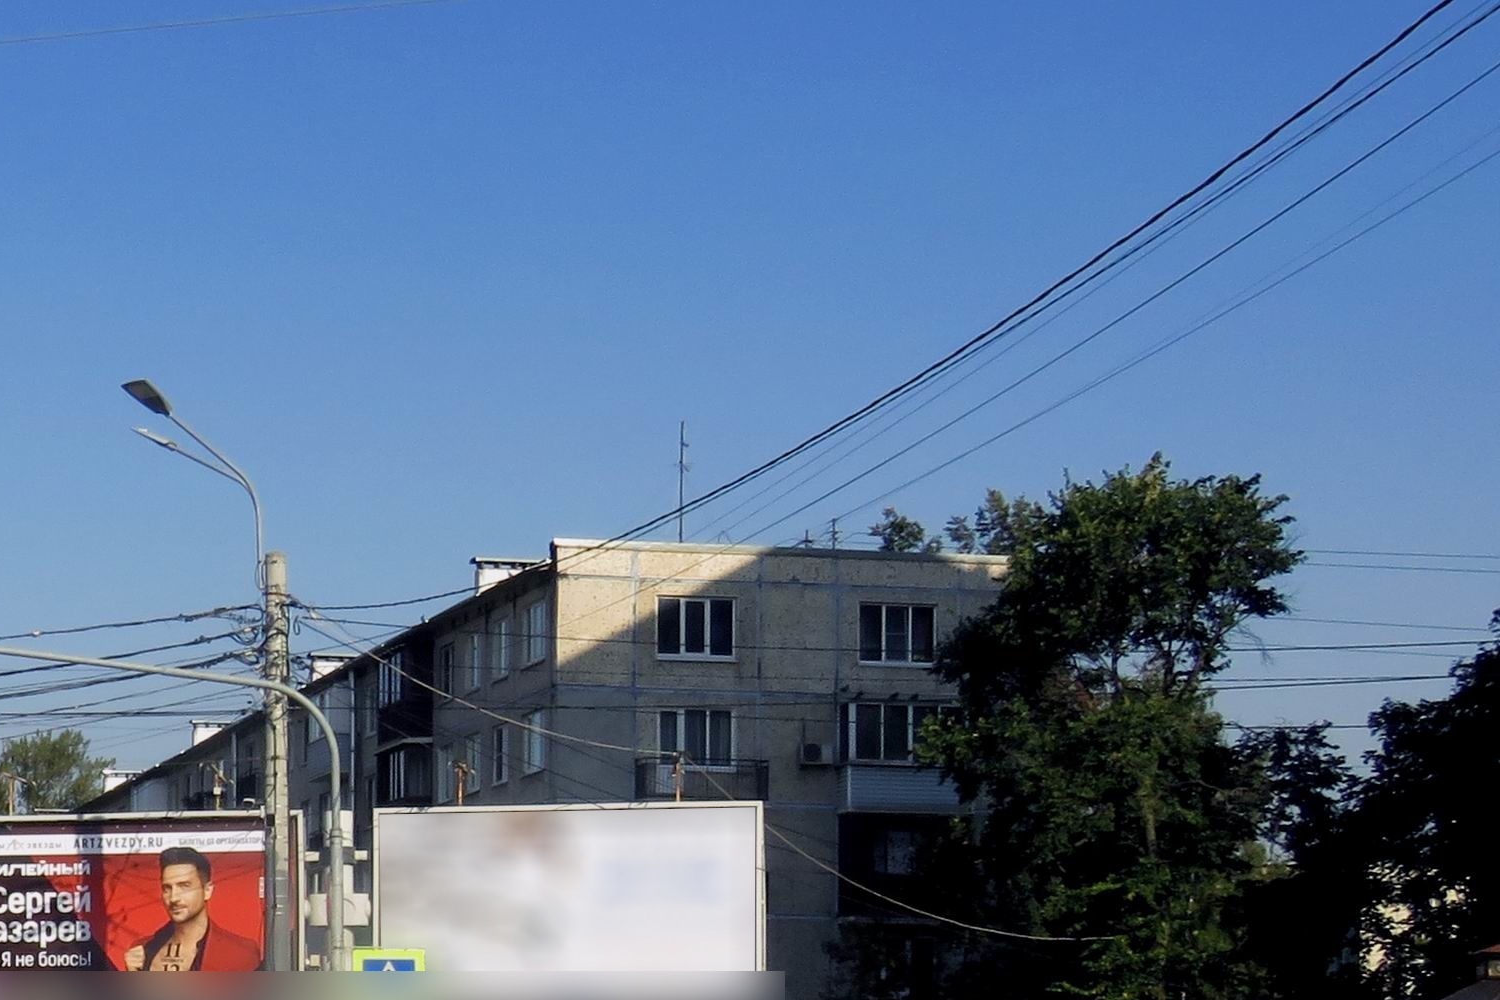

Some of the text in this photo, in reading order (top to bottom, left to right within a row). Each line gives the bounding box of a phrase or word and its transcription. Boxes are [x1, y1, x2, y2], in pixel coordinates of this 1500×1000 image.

[73, 836, 164, 849] ARTZVEZDY.RU
[164, 942, 182, 958] 11
[1, 951, 12, 967] Я
[15, 954, 34, 967] не
[38, 951, 92, 967] боюсь!
